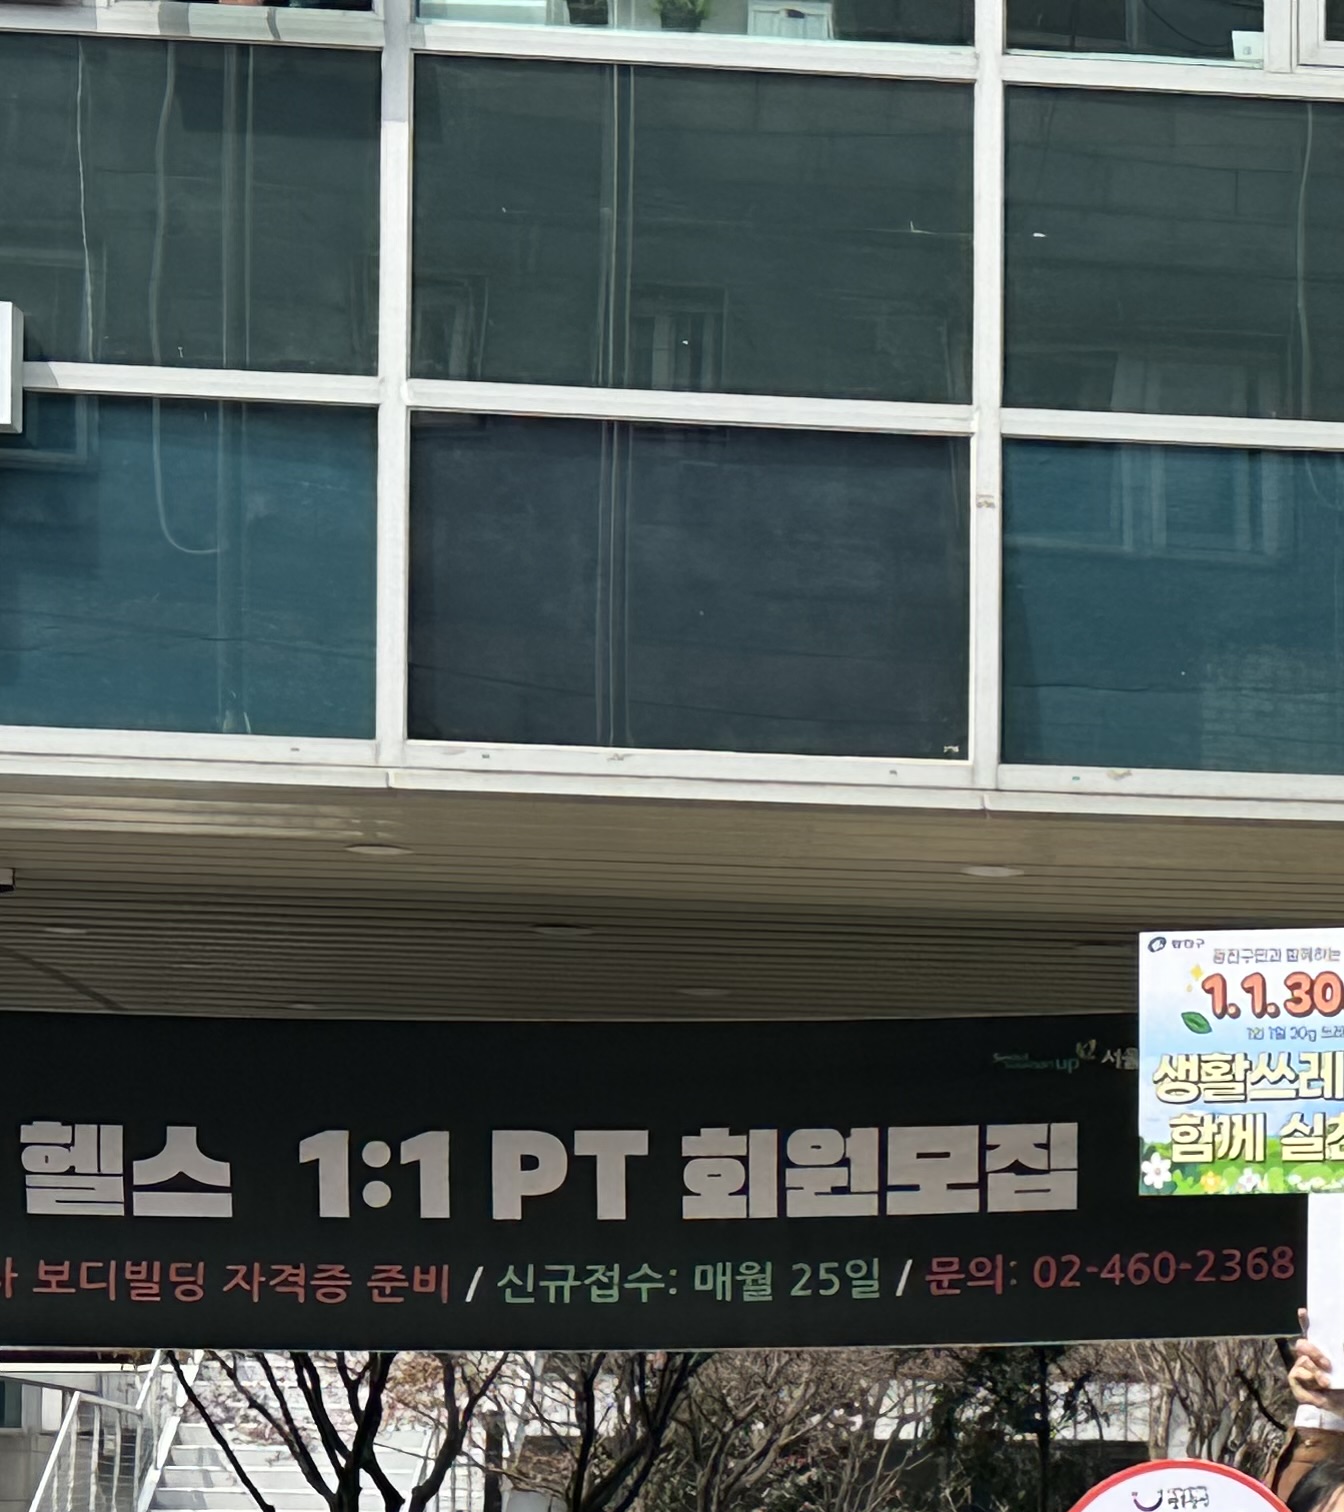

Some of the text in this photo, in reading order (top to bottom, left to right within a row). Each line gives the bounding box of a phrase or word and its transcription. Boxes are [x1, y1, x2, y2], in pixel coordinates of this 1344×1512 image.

[1169, 1112, 1267, 1164] 함께
[20, 1120, 1079, 1220] 헬스 1:1 PT 회원모집
[33, 1260, 205, 1302] 보디빌딩
[222, 1263, 352, 1303] 자격증
[366, 1264, 449, 1303] 준비
[497, 1265, 678, 1303] 신규접수:
[694, 1261, 773, 1302] 매월
[791, 1259, 881, 1297] 25일
[925, 1254, 1017, 1295] 문의:
[1033, 1246, 1295, 1289] 02-460-2368
